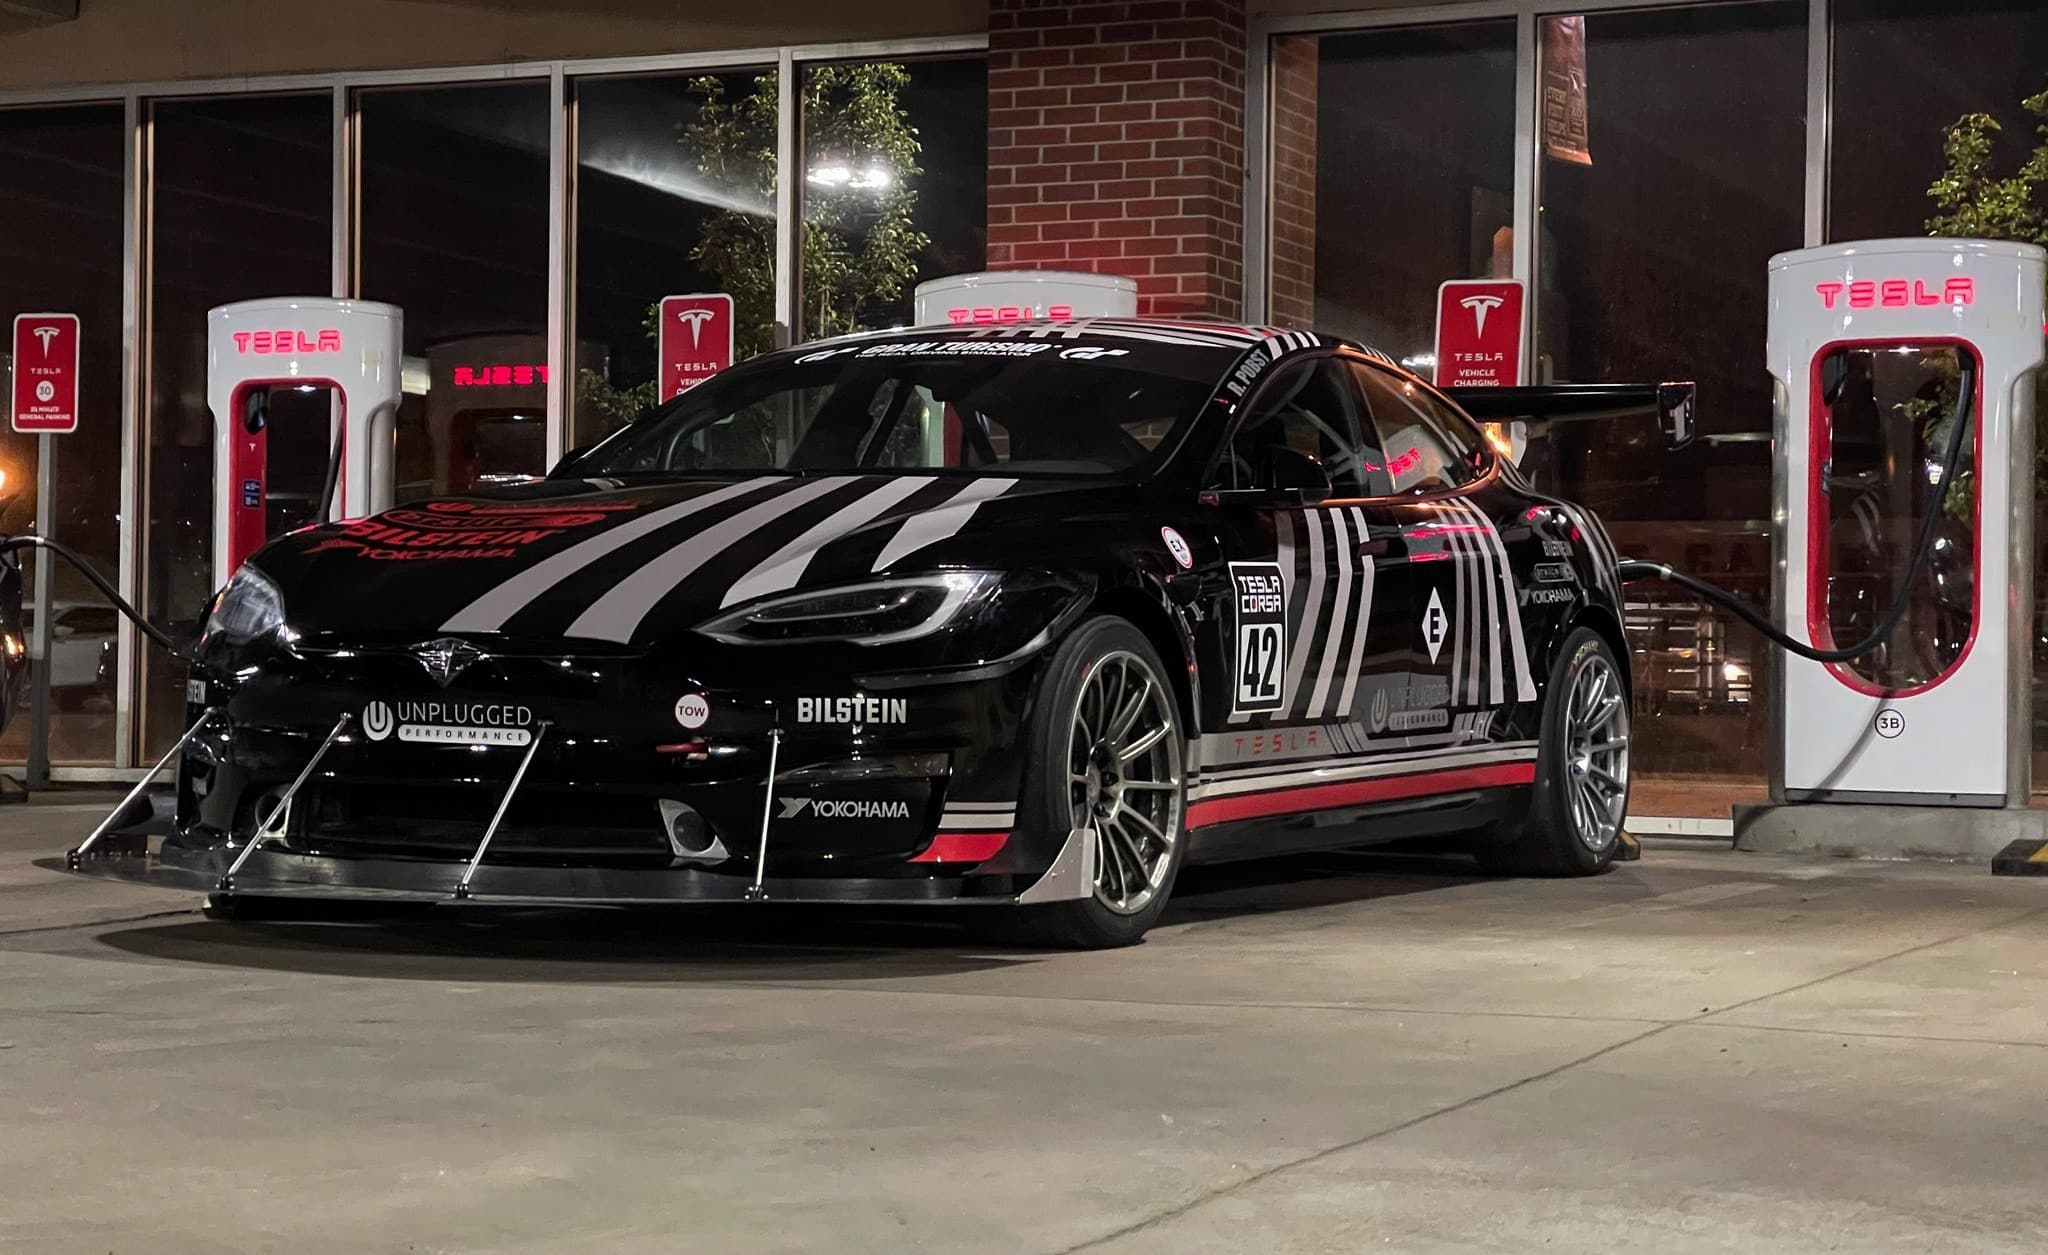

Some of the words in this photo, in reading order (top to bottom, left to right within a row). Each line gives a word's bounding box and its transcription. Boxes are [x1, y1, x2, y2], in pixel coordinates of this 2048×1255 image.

[1816, 278, 1974, 308] TESLA
[232, 329, 341, 354] TESLA
[861, 342, 939, 354] GRAN
[934, 341, 1052, 352] TURISMO
[1454, 352, 1503, 361] TESLA
[30, 367, 61, 375] TESLA
[675, 362, 717, 371] TESLA
[1234, 348, 1270, 385] POBST
[39, 386, 51, 395] 30
[1227, 381, 1247, 397] R.
[1454, 379, 1500, 387] CHARGING
[342, 519, 556, 546] BILSTEIN
[1238, 576, 1281, 594] TESLA
[1241, 595, 1281, 613] CORSA
[1430, 607, 1441, 643] E
[1243, 626, 1278, 698] 42
[398, 701, 531, 726] UNPLUGGED
[678, 705, 705, 717] TOW
[798, 697, 907, 723] BILSTEIN
[1880, 718, 1900, 729] 3B
[405, 728, 524, 741] PERFORMANCE
[1234, 730, 1318, 757] TESLA
[811, 800, 909, 818] YOKOHAMA
